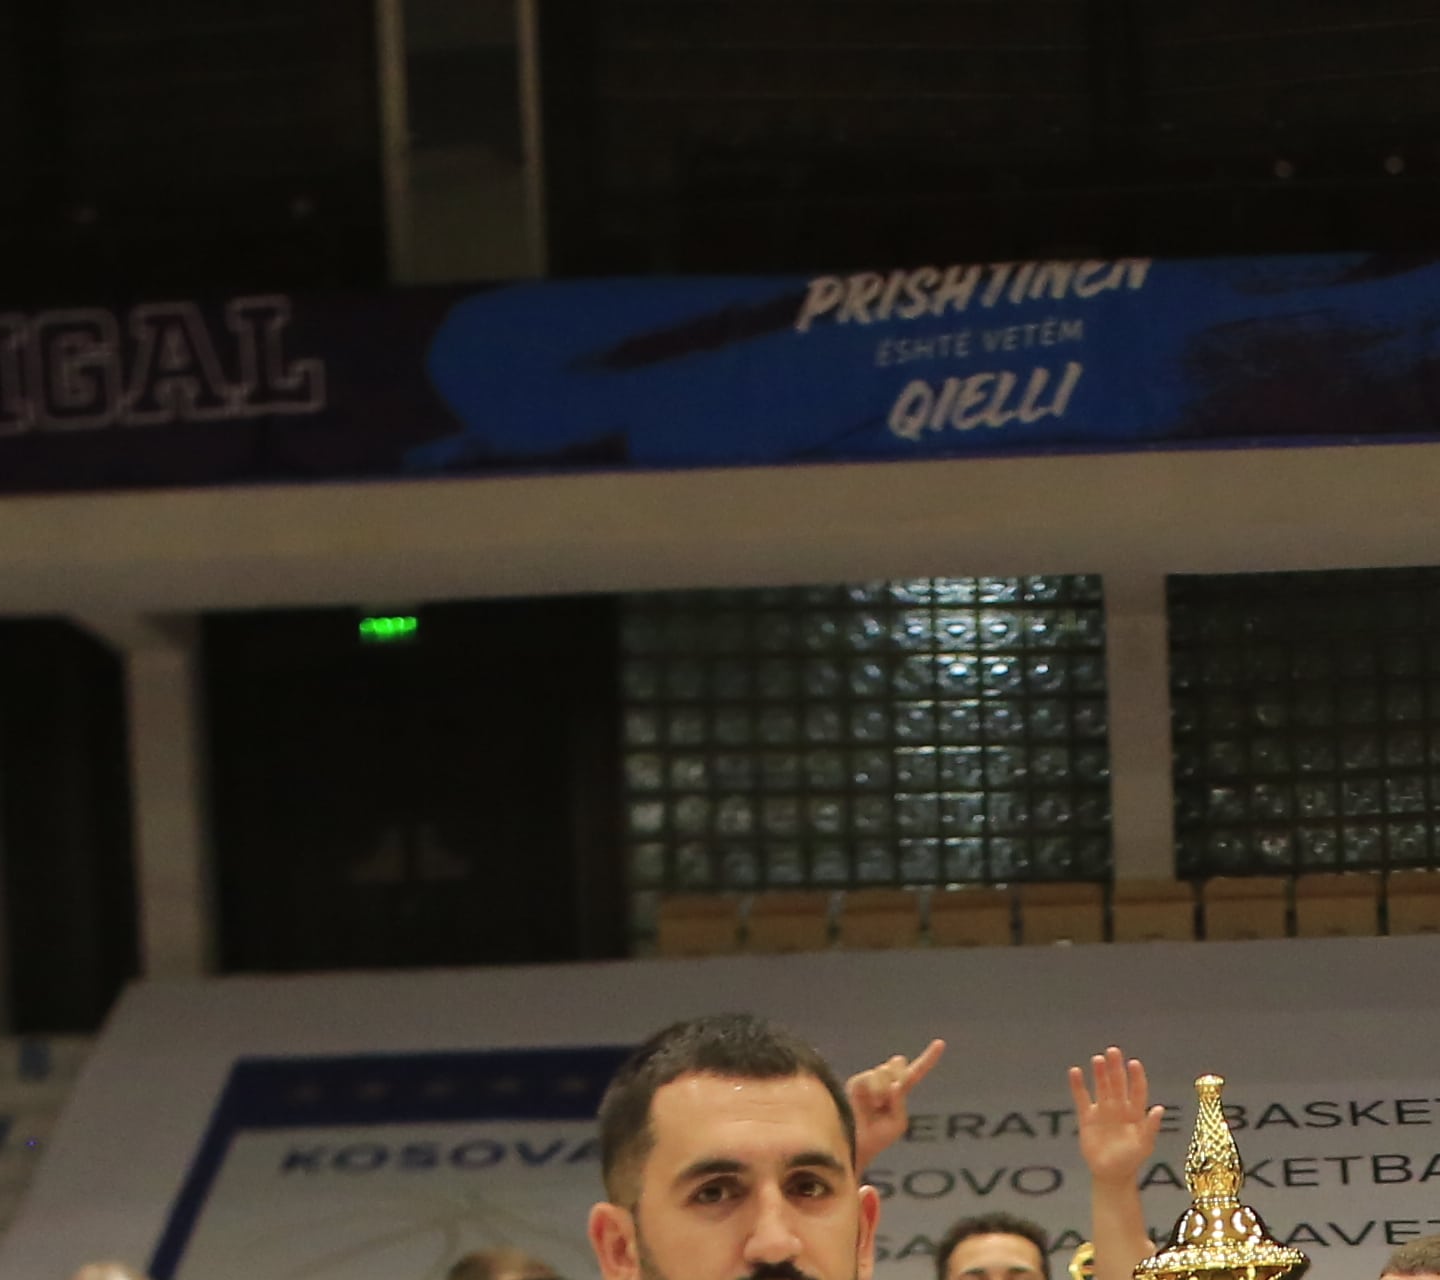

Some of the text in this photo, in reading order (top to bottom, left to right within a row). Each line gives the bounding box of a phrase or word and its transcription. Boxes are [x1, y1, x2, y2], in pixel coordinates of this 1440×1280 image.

[888, 360, 1083, 442] QIELLI
[903, 1108, 1081, 1143] ERAT
[862, 1165, 1063, 1201] SOVO
